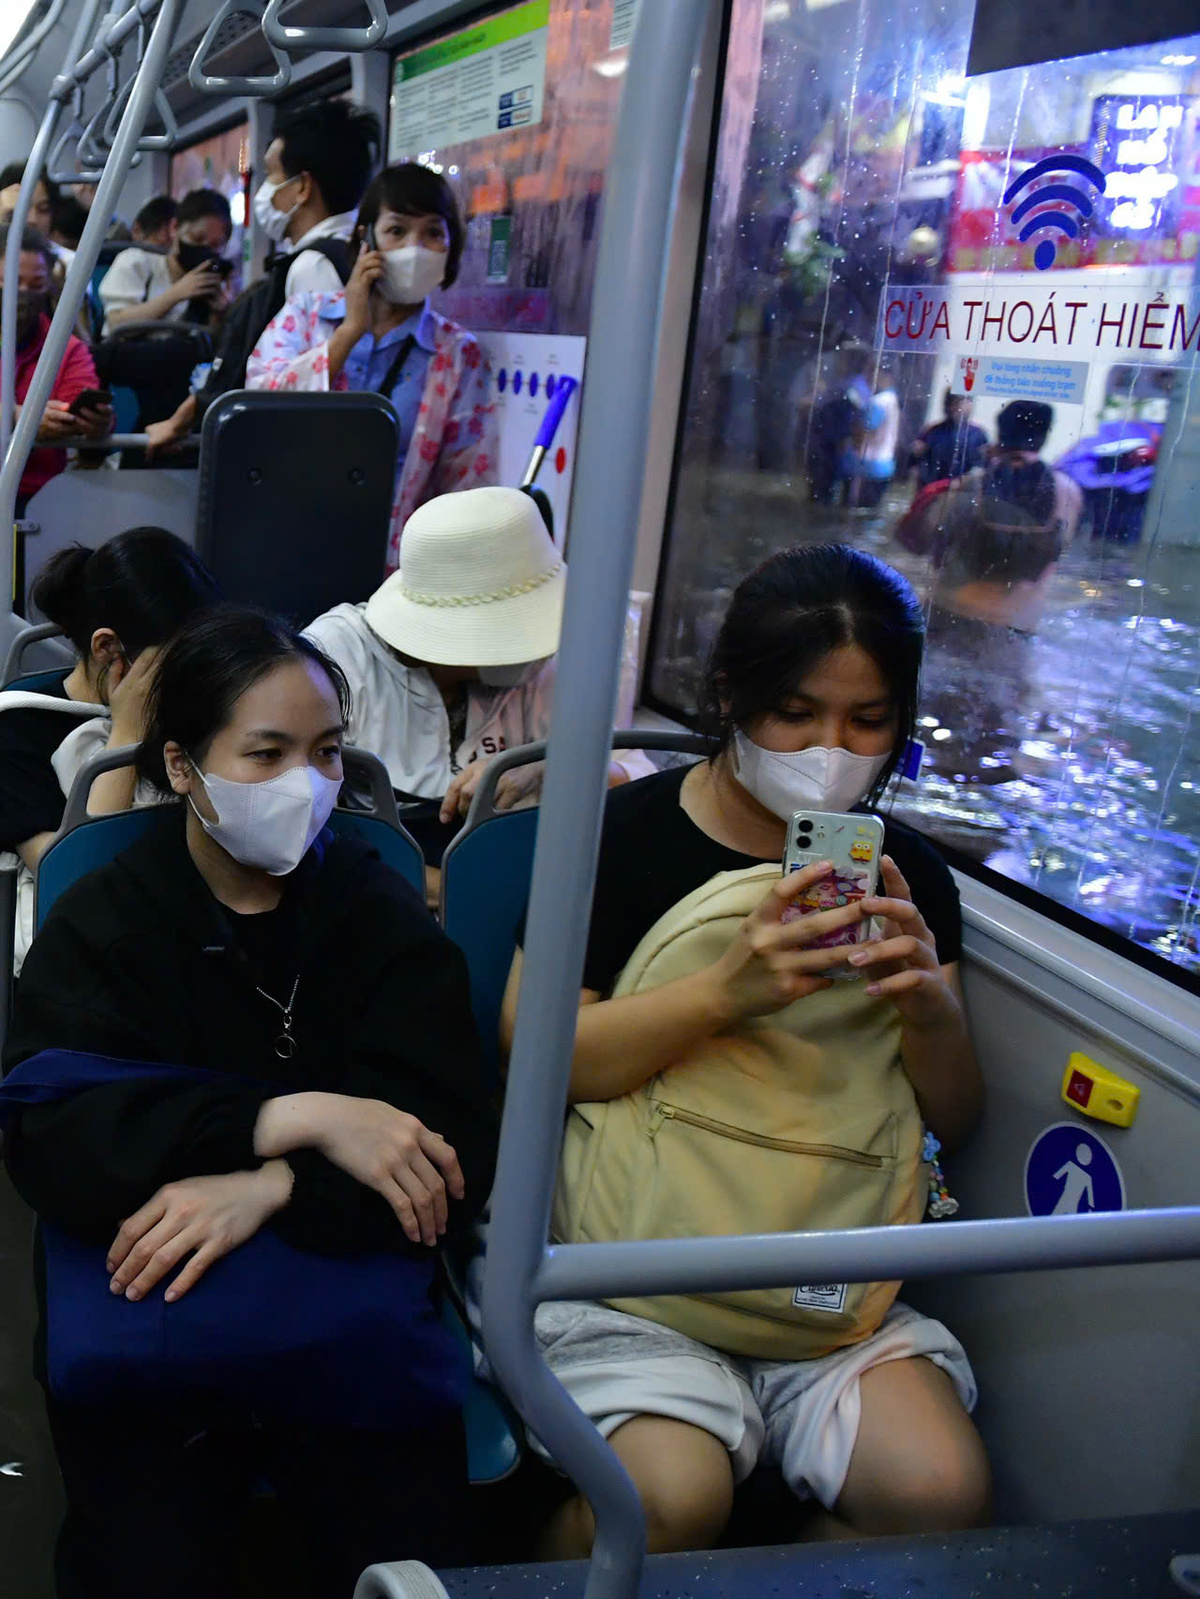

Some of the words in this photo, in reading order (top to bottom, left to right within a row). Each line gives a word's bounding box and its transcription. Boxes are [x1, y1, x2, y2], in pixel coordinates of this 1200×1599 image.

[885, 291, 950, 340] CỬA
[962, 291, 1088, 345] THOÁT
[1095, 291, 1200, 351] HIỂM
